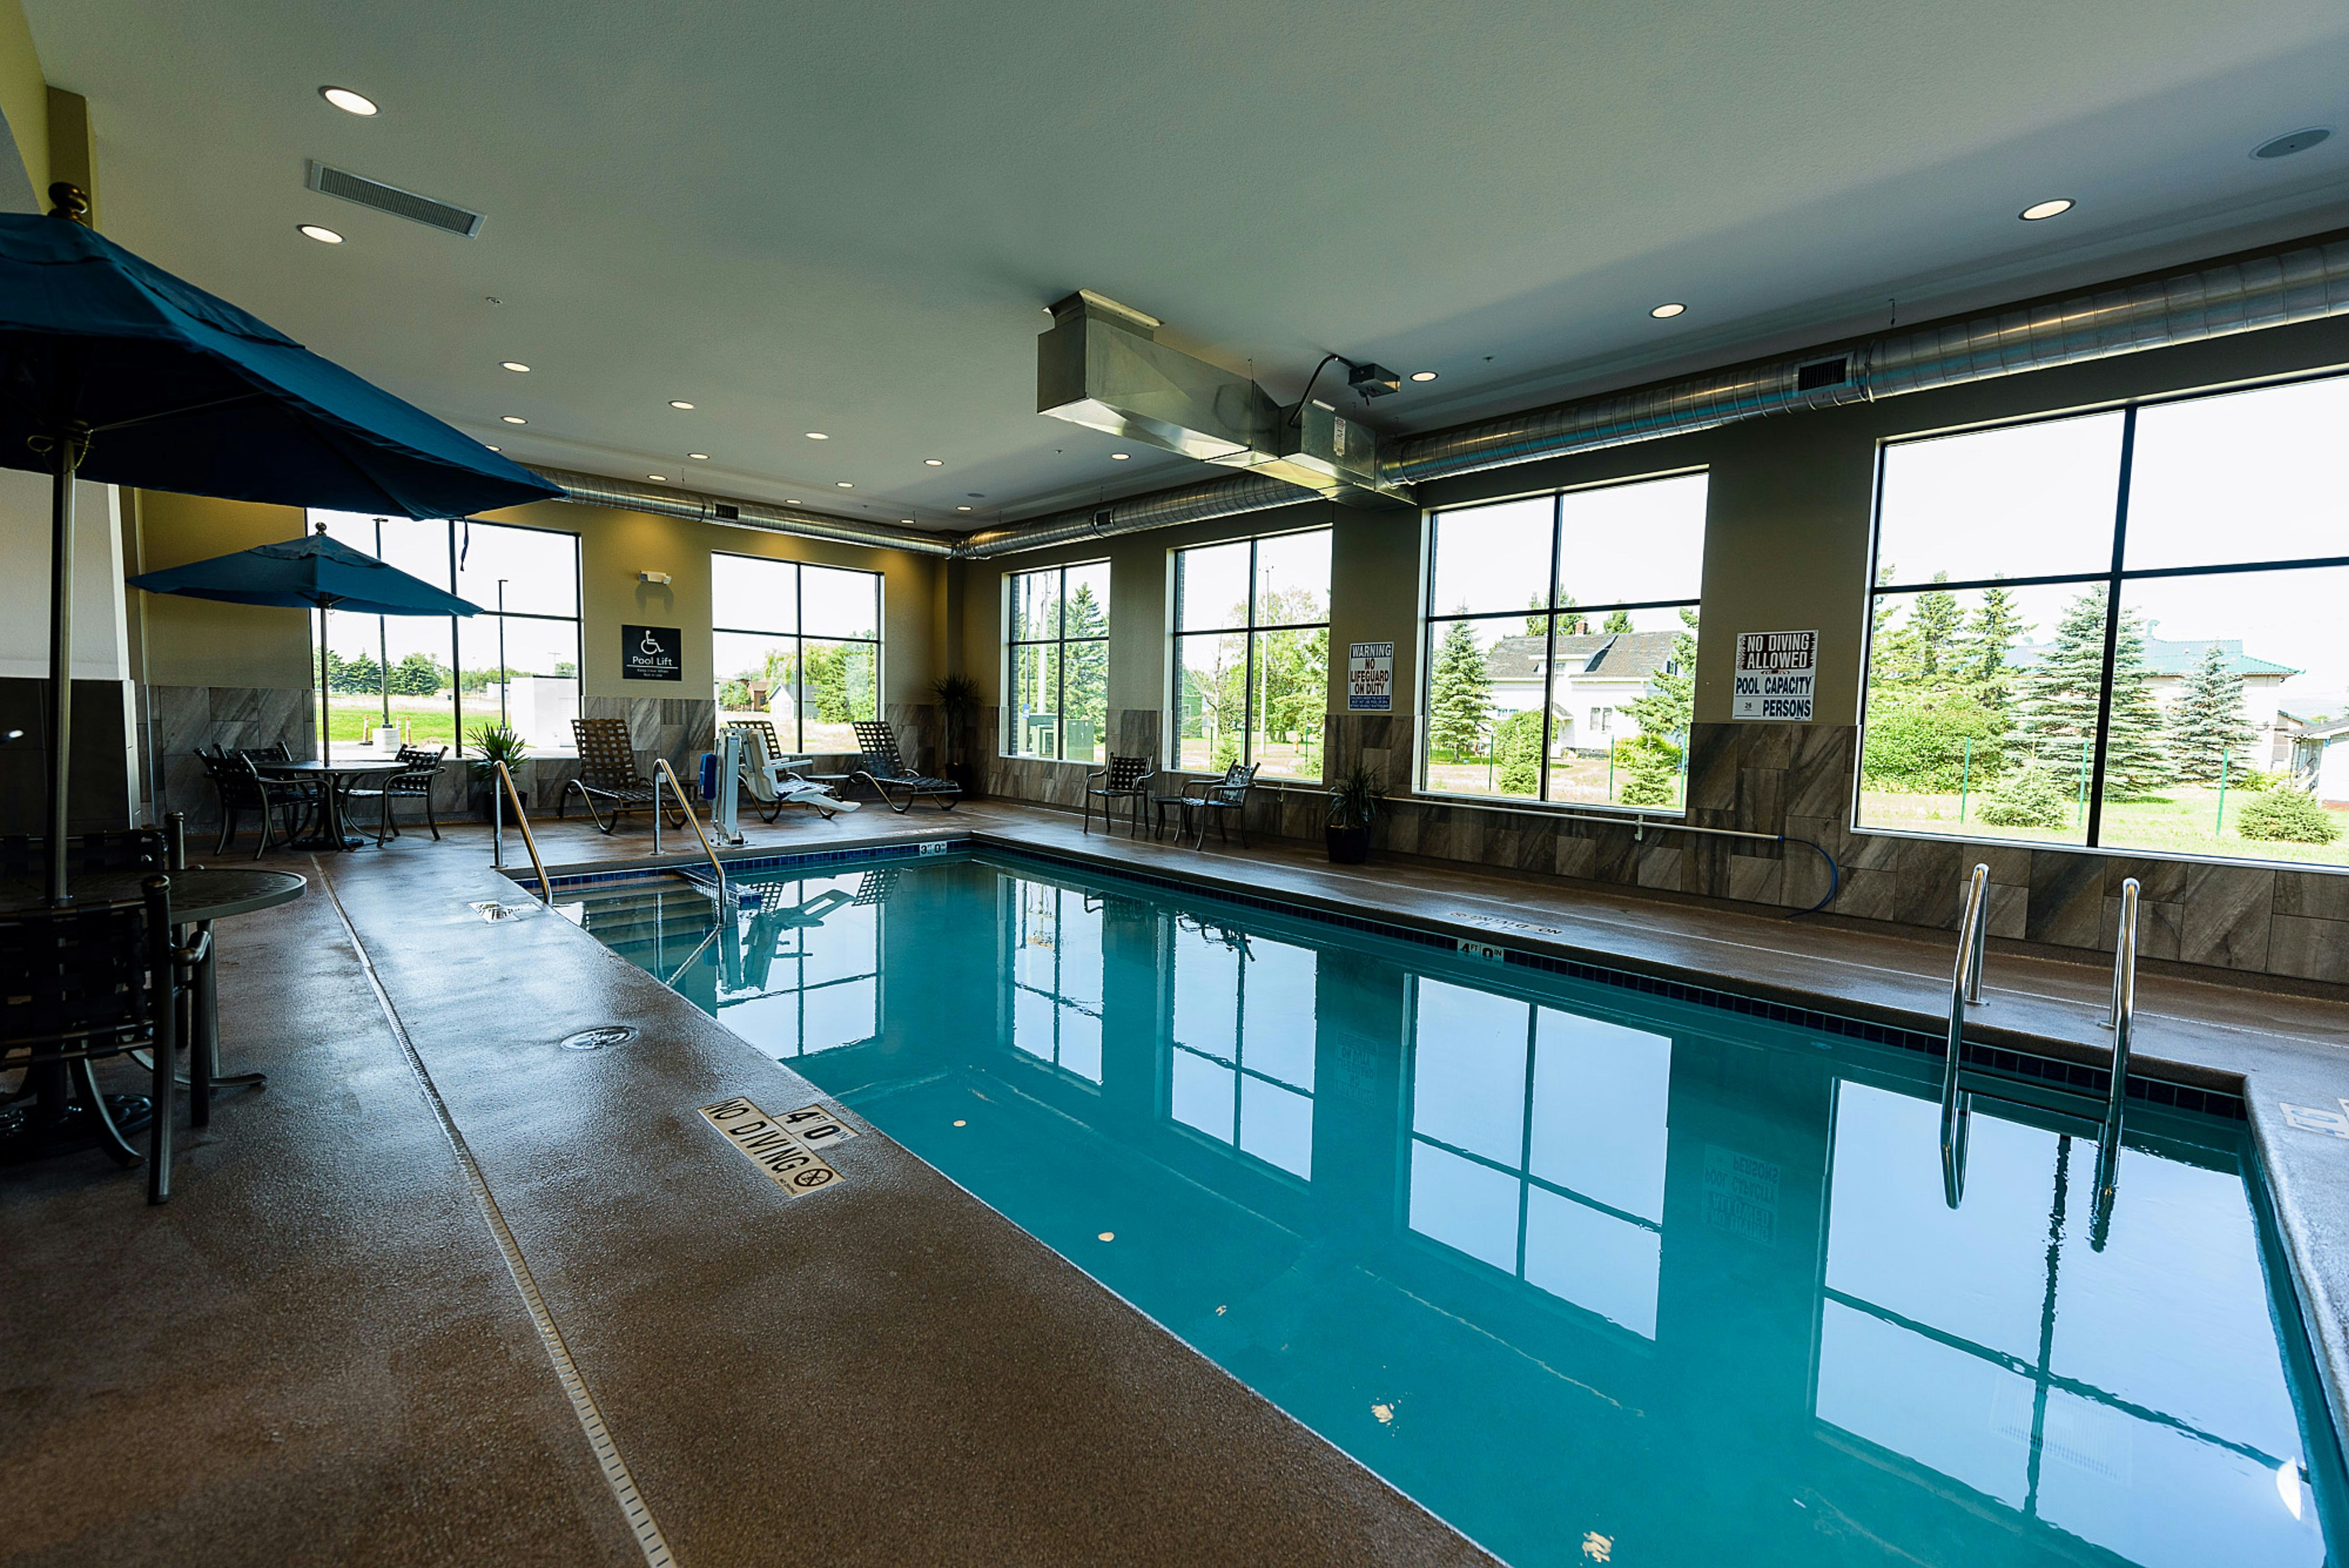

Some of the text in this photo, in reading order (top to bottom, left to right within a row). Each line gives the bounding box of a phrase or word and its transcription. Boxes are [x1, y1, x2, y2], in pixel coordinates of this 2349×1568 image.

[1747, 633, 1810, 652] NO DIVING
[1352, 644, 1391, 658] WARNING
[632, 656, 672, 666] Pool Lift
[1365, 658, 1375, 670] NO
[1747, 651, 1808, 669] ALLOWED
[1351, 670, 1389, 683] LIFEGUARD
[1355, 683, 1385, 695] ON DUTY
[1736, 676, 1812, 695] POOL CAPACITY
[1763, 699, 1811, 717] PERSONS
[920, 845, 928, 855] 3
[1459, 943, 1470, 953] 4
[786, 1112, 820, 1124] 4
[803, 1125, 840, 1139] 0
[705, 1099, 810, 1174] NO DIVING
